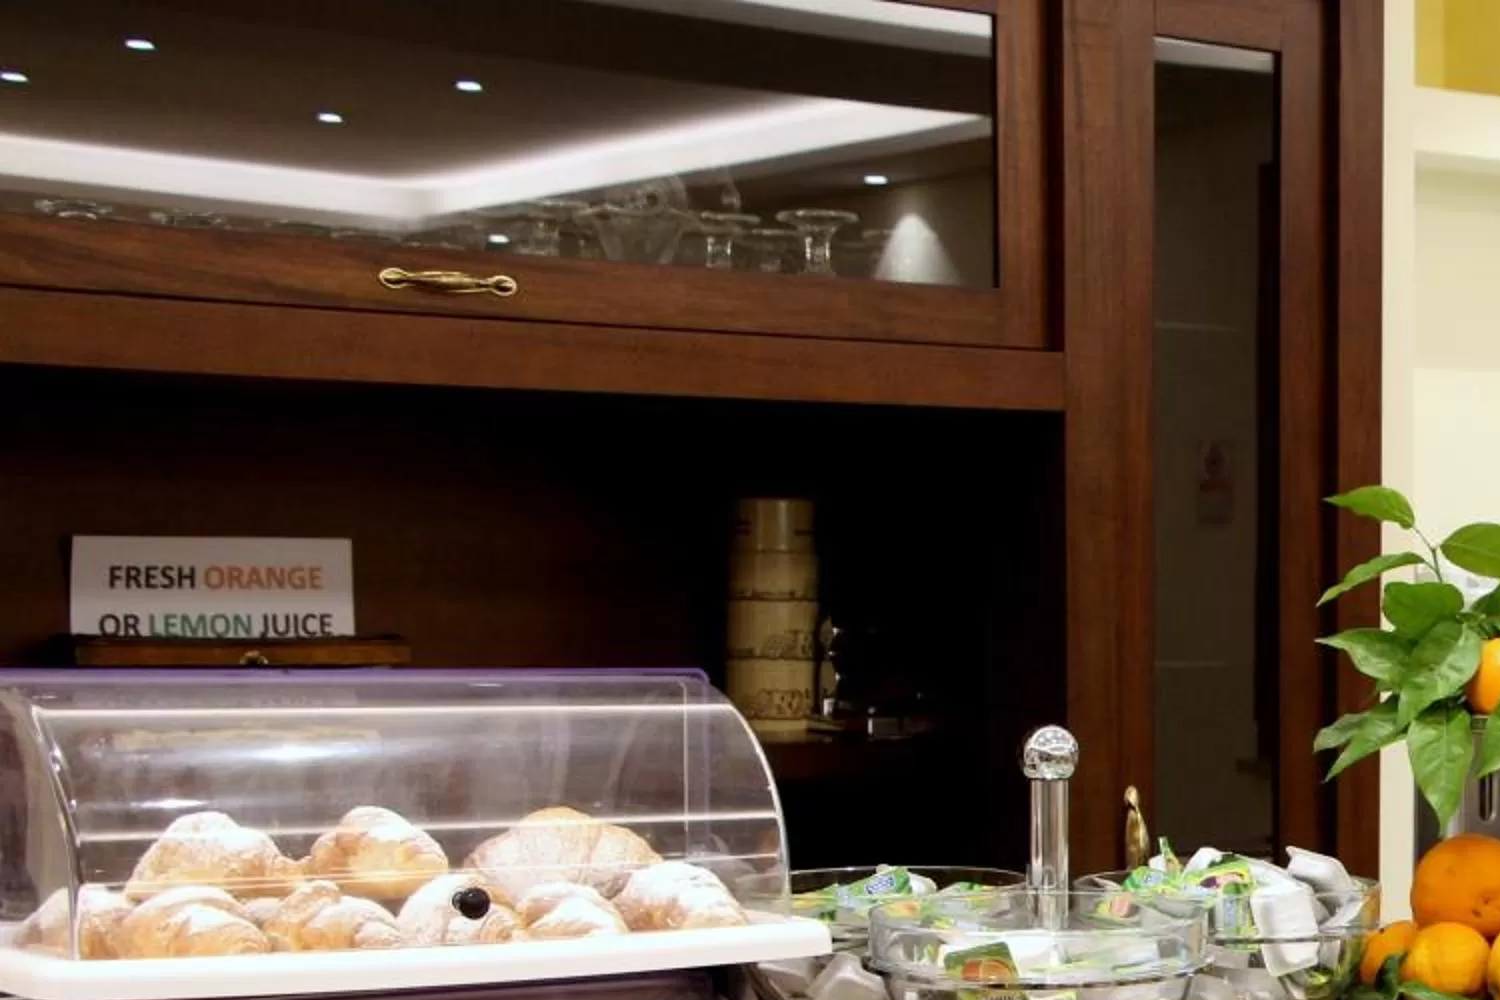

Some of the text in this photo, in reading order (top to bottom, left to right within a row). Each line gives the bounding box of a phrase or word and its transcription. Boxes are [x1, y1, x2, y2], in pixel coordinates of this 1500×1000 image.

[108, 565, 323, 590] FRESH ORANGE
[99, 613, 333, 638] OR LEMON JUICE
